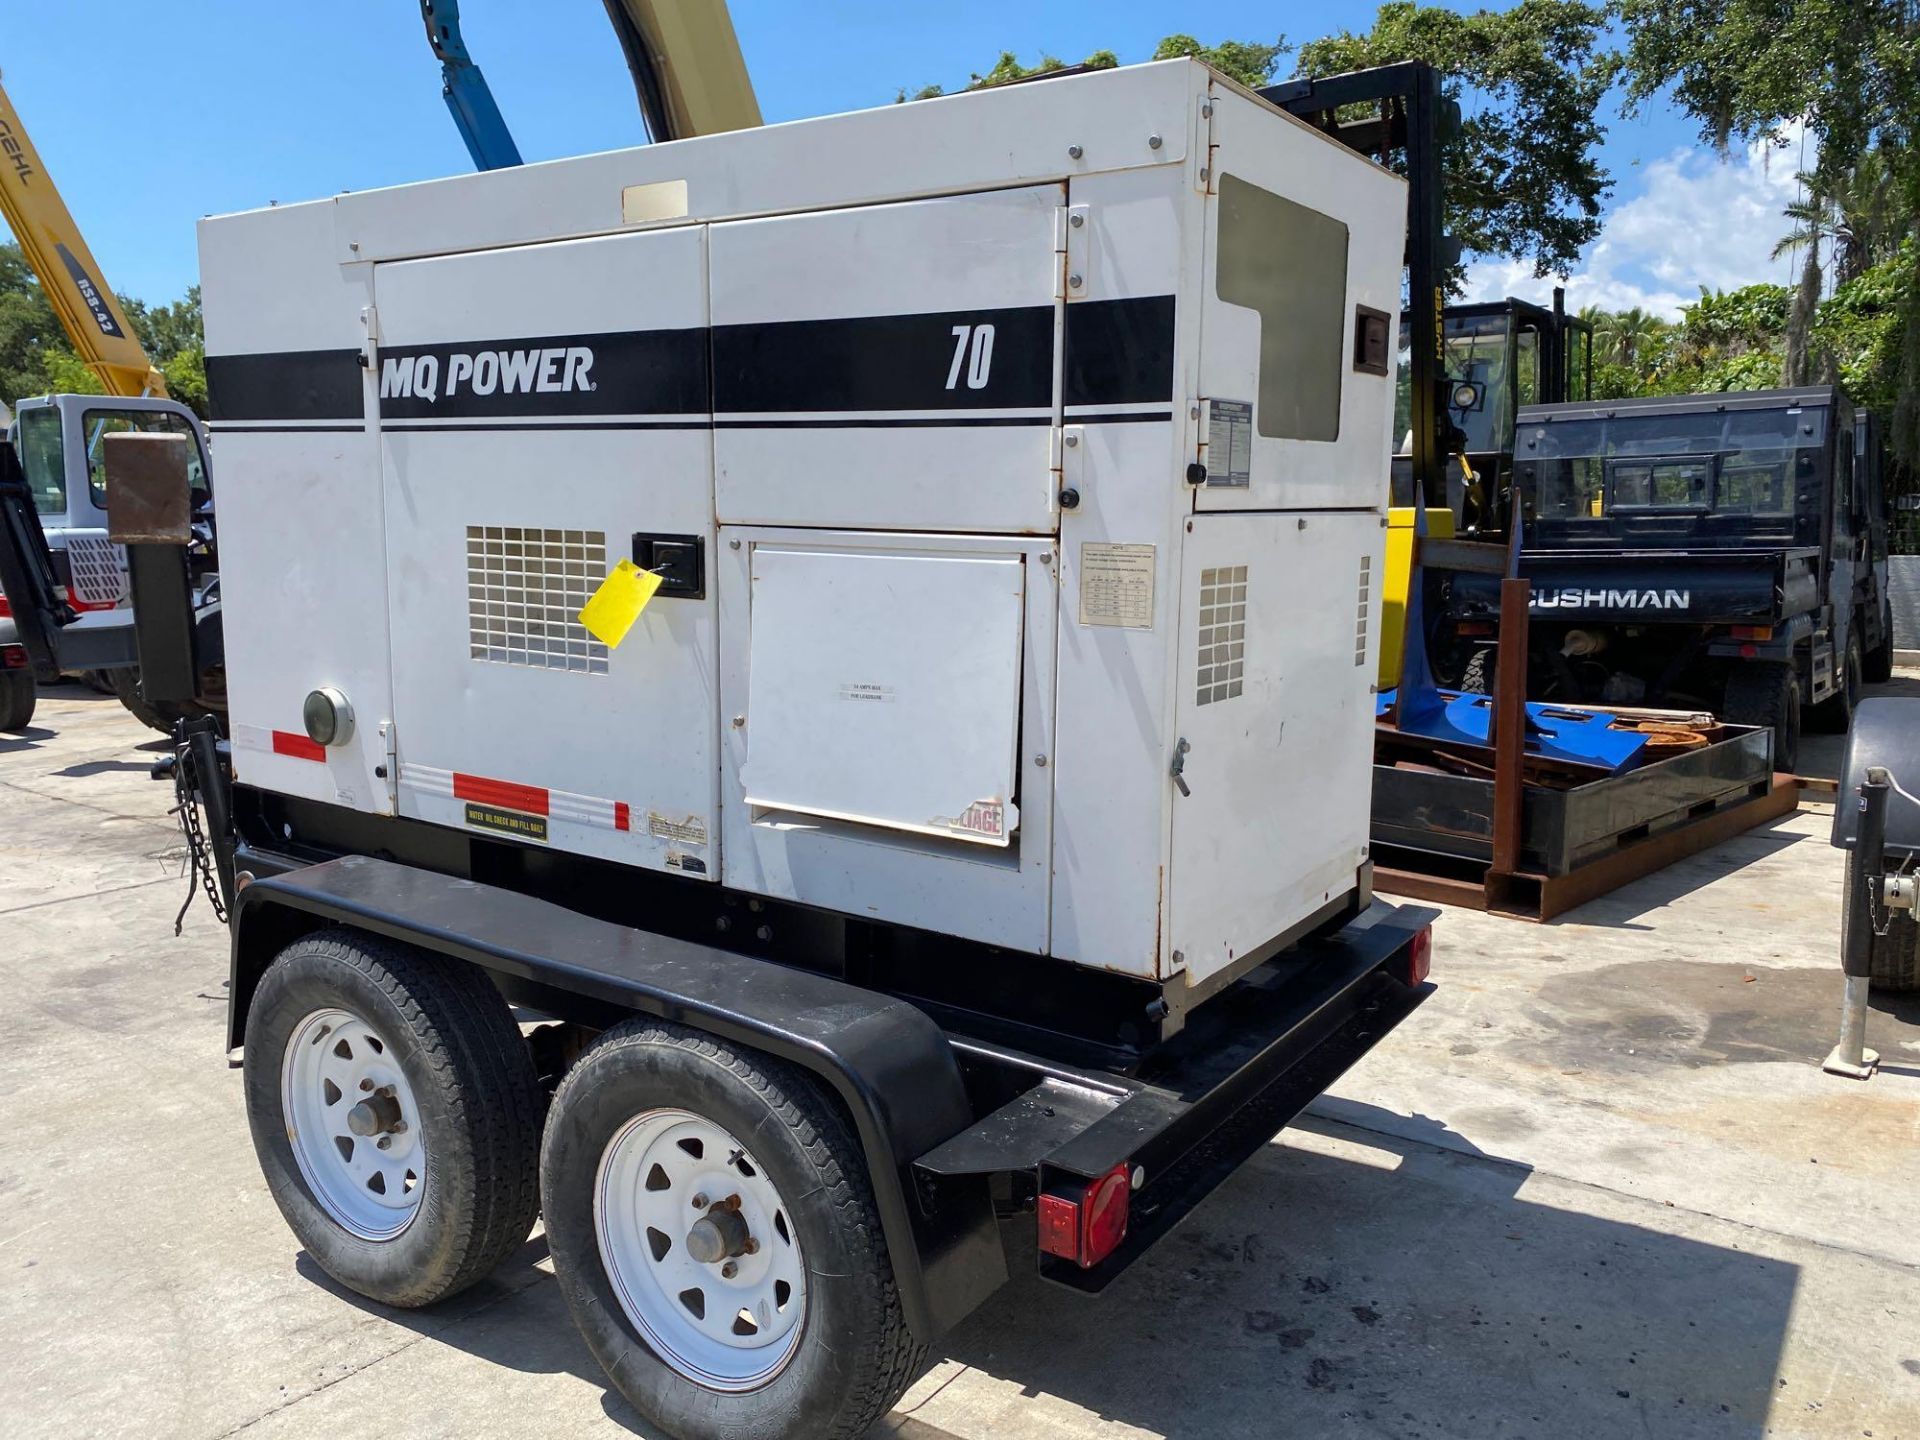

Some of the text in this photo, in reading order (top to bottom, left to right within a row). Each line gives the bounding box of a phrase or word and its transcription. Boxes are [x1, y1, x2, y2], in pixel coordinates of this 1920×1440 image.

[1434, 286, 1444, 360] HYSTER
[380, 355, 439, 403] MQ
[945, 324, 995, 389] 70
